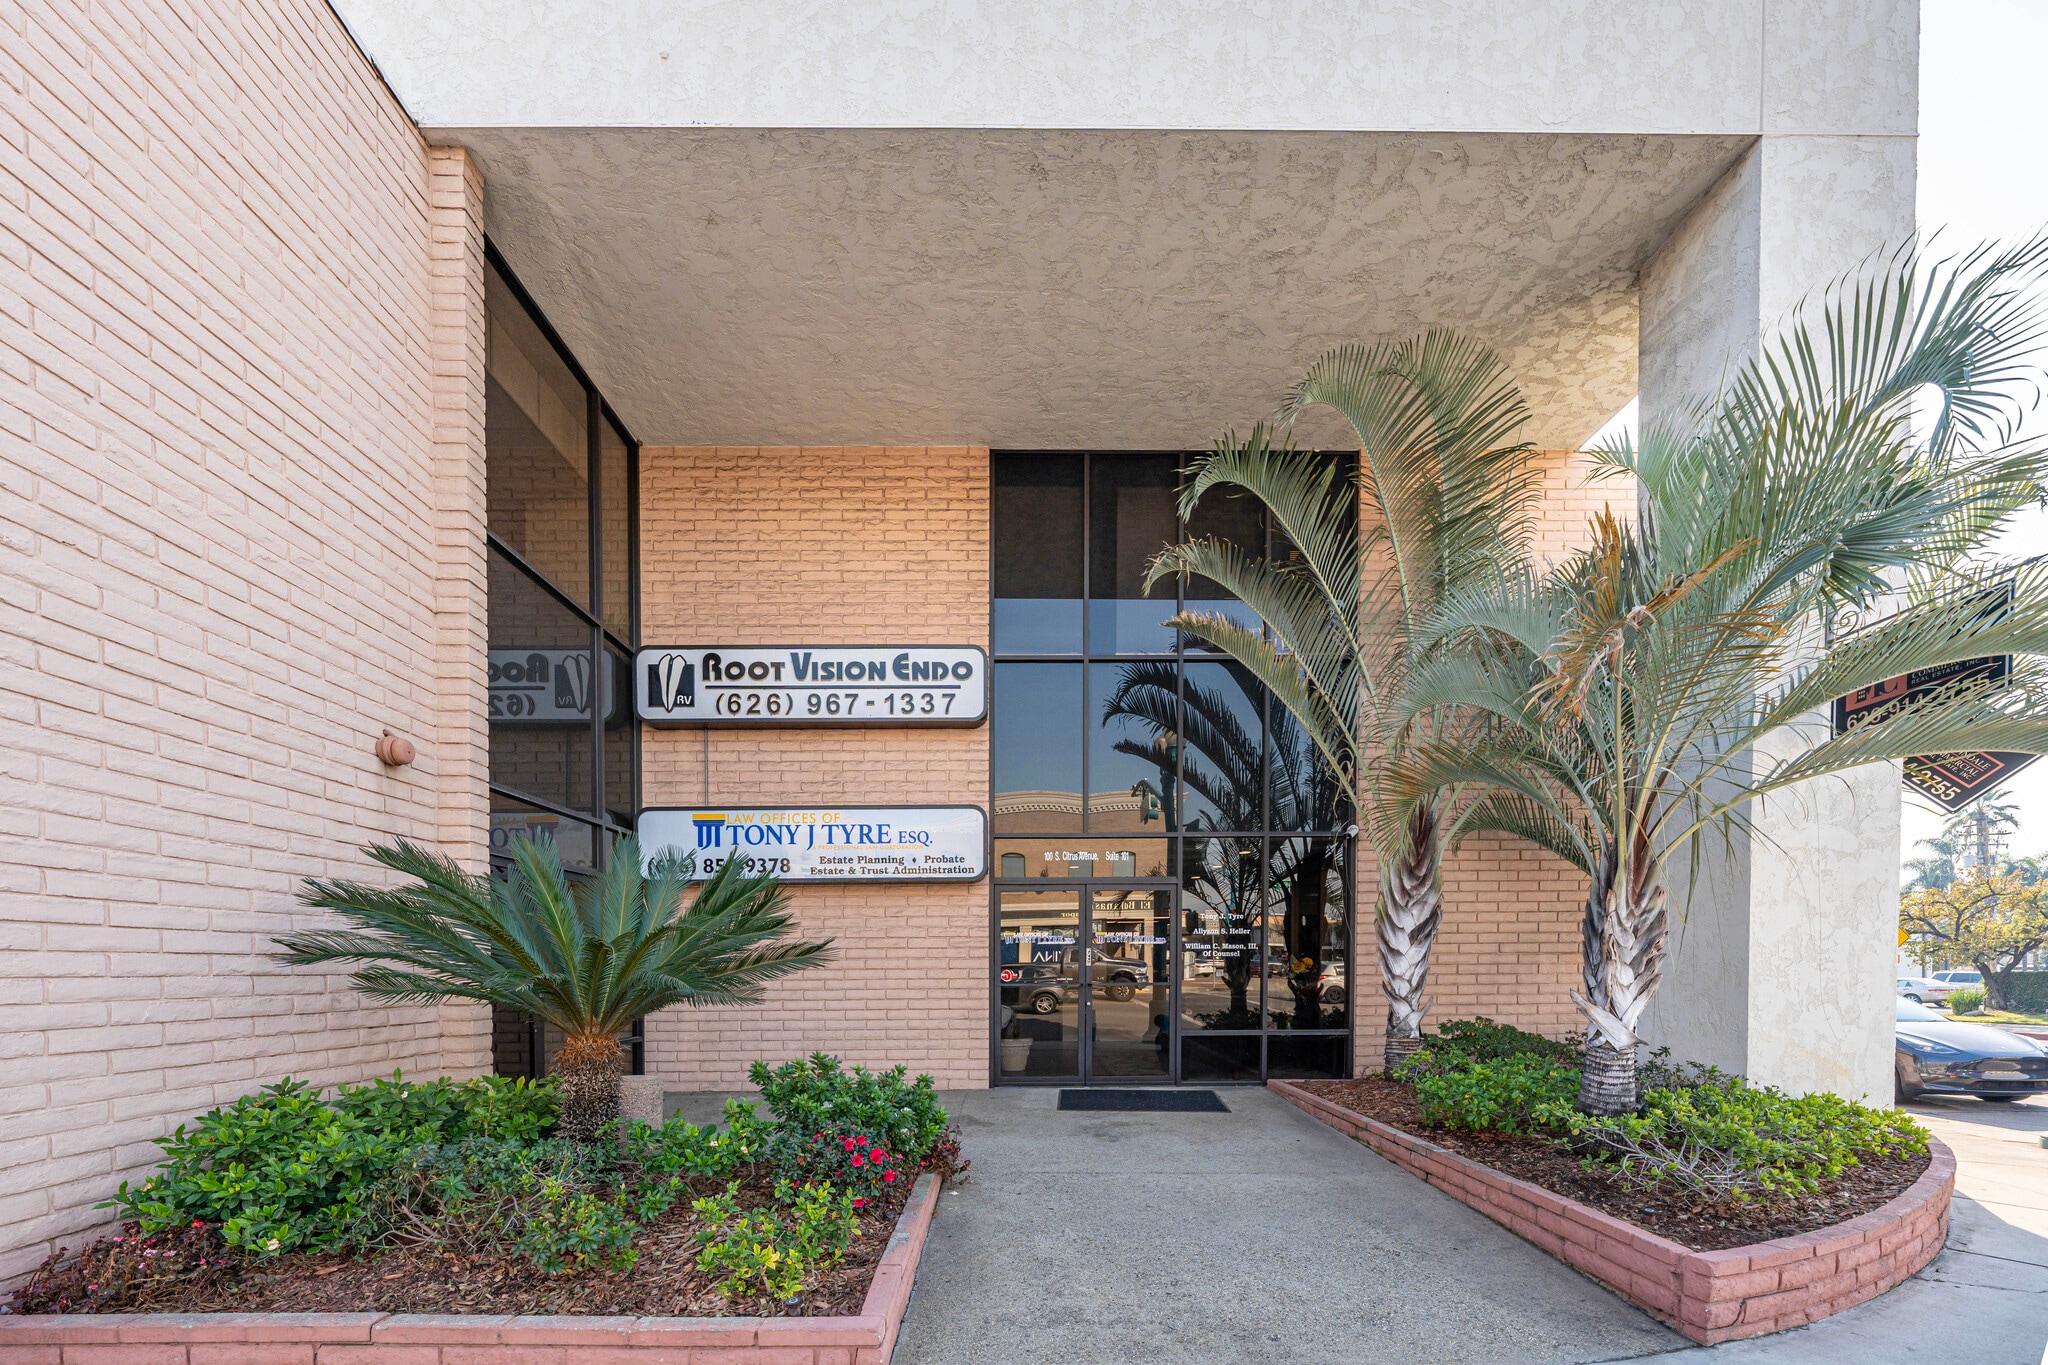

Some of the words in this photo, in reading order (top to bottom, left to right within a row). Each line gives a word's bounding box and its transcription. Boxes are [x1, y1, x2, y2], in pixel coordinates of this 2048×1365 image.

[702, 652, 786, 682] ROOT
[790, 652, 887, 682] VISION
[893, 652, 973, 682] ENDO
[1911, 675, 1930, 685] REAL
[677, 695, 692, 705] RV
[716, 693, 794, 716] (626)
[727, 813, 755, 825] LAW
[760, 812, 817, 825] OFFICES
[822, 812, 841, 824] OF
[726, 824, 801, 846] TONY
[806, 824, 816, 851] J
[821, 824, 892, 845] TYRE
[898, 830, 933, 847] ESQ.
[819, 855, 854, 865] Estate
[857, 855, 905, 866] Planning
[924, 855, 966, 864] Probate
[1105, 851, 1119, 861] Suite
[810, 866, 845, 875] Estate
[848, 866, 857, 875] &
[860, 866, 889, 875] Trust
[892, 865, 975, 875] Administration
[1200, 913, 1218, 921] Tony
[1193, 928, 1219, 936] Allyson
